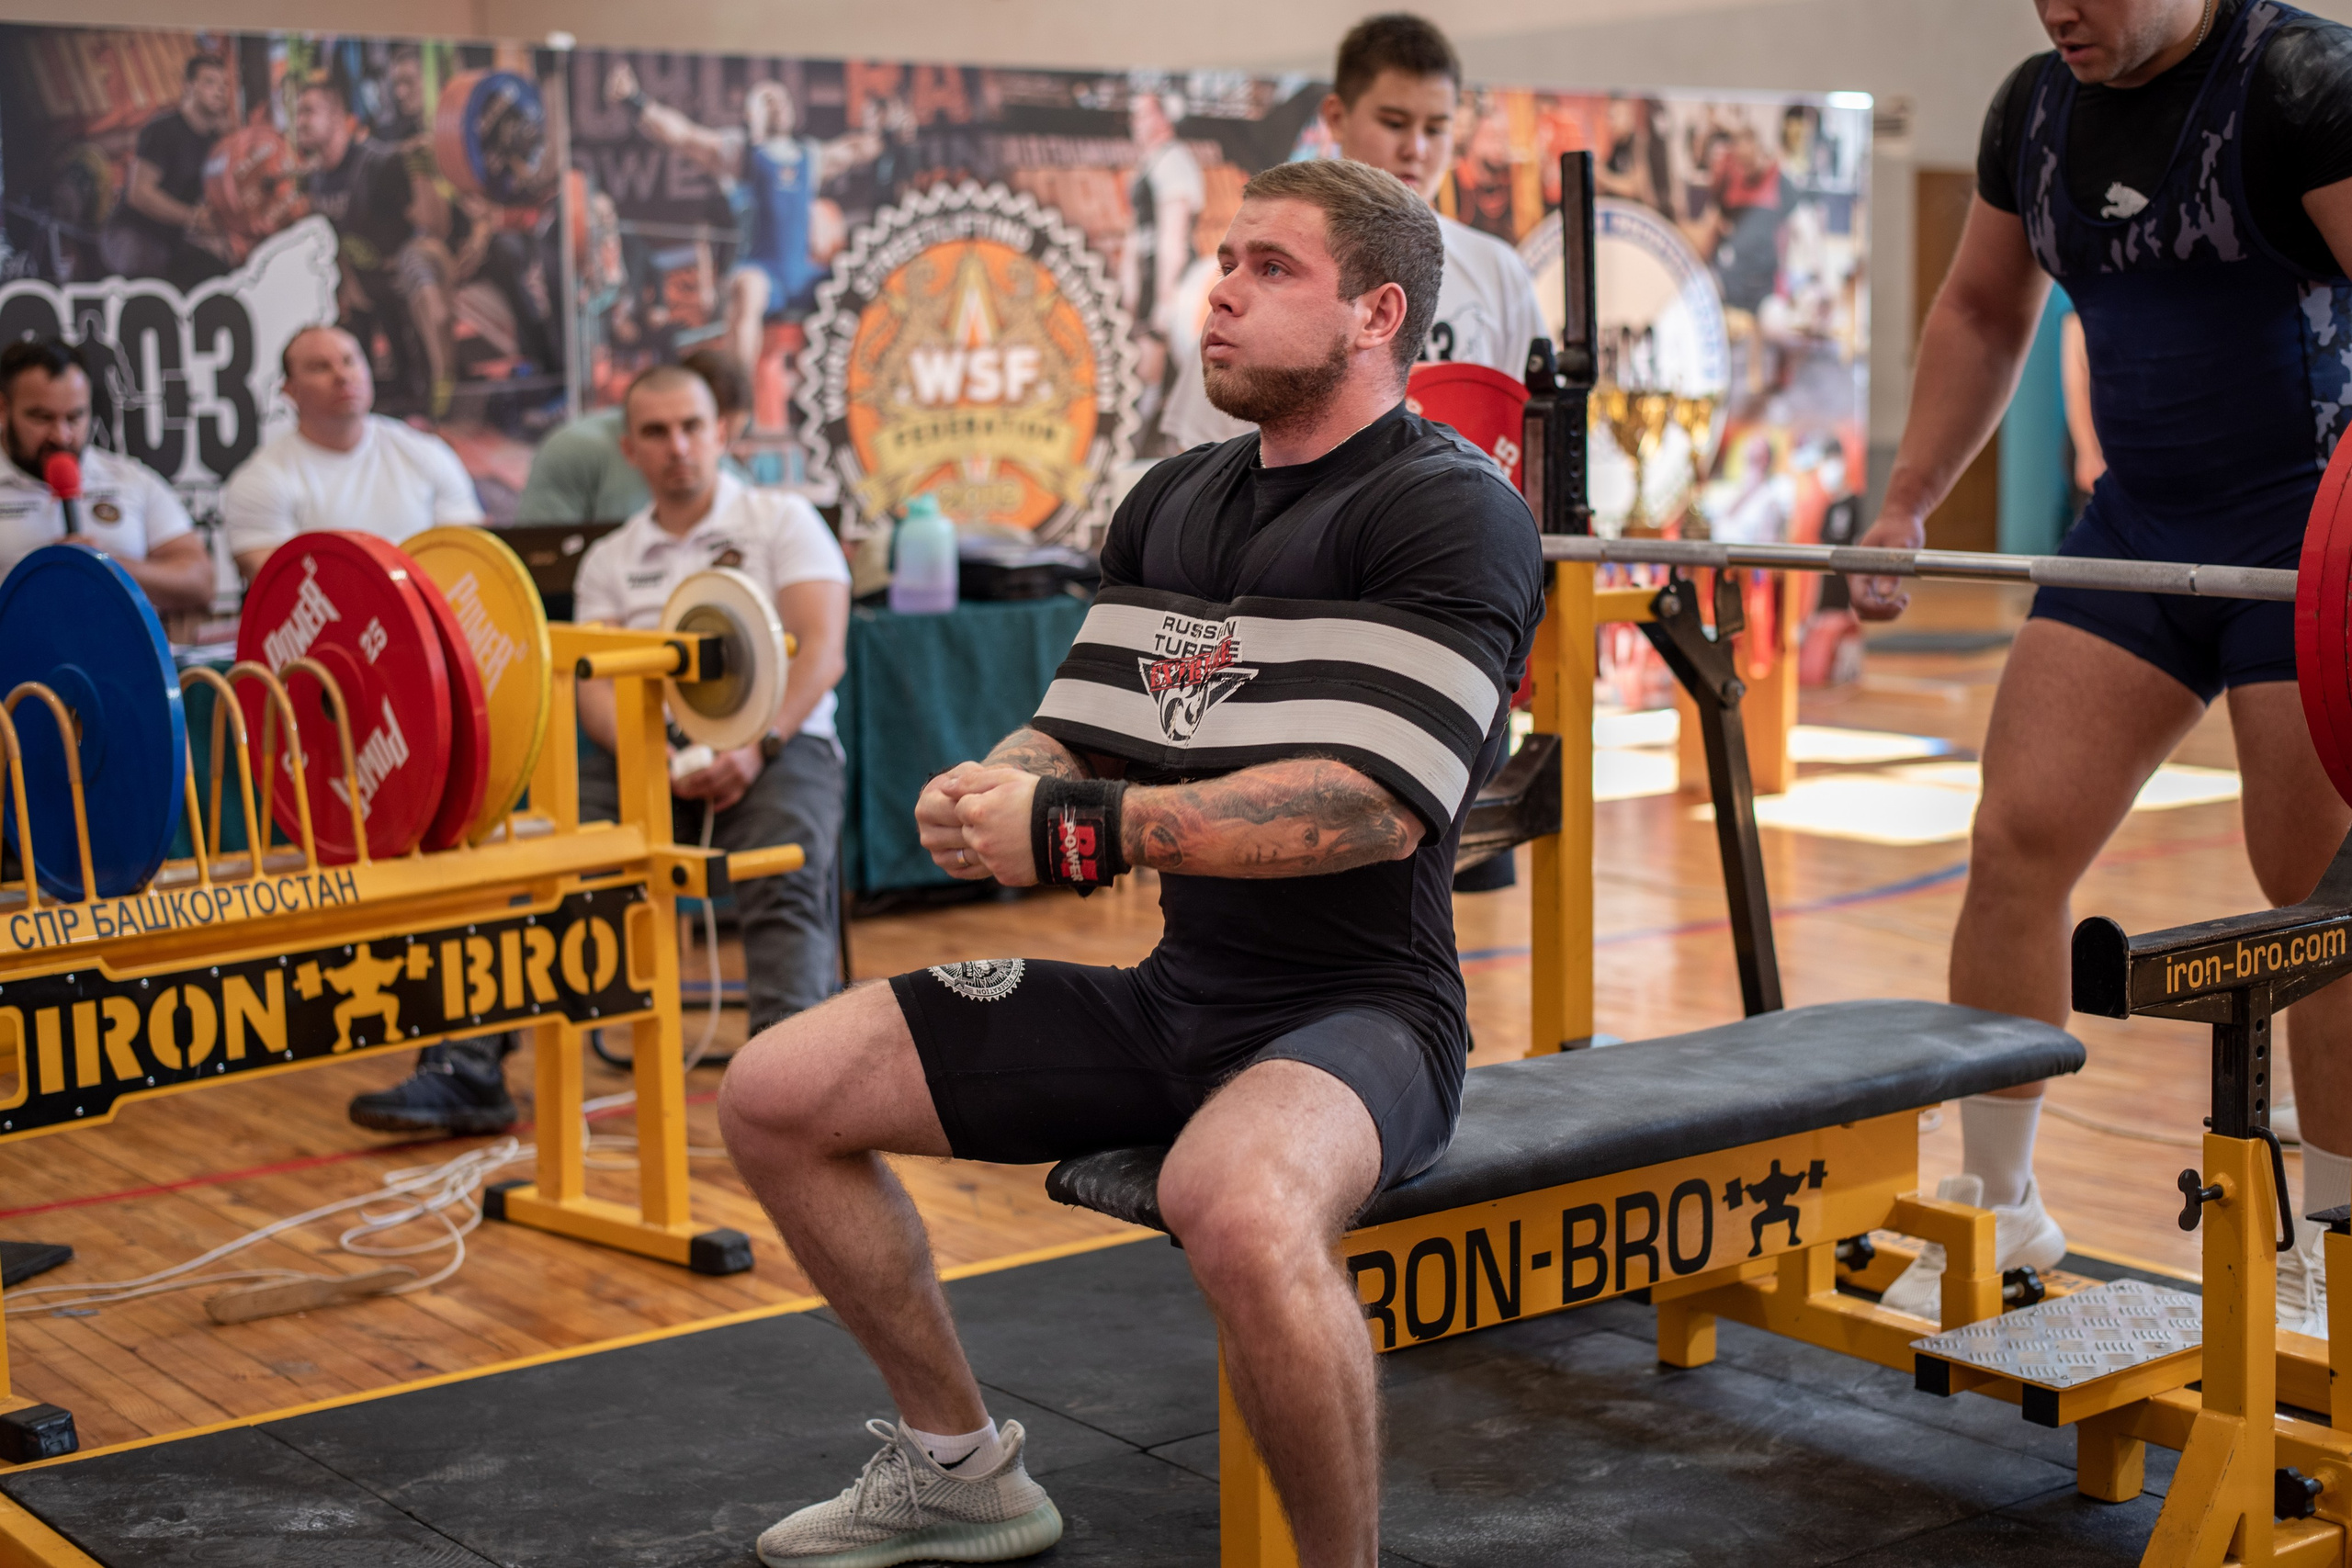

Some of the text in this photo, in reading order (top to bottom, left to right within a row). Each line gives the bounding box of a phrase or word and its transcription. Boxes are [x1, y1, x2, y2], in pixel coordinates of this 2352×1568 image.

[908, 345, 1042, 404] WSF
[1162, 615, 1238, 641] RUSSAN
[1063, 816, 1085, 882] POWER
[10, 869, 360, 950] СПР БАШКОРТОСТАН
[976, 976, 1013, 996] FEDERATION
[2166, 928, 2346, 995] iron-bro.com
[35, 918, 619, 1095] IRON BRO
[1345, 1178, 1714, 1349] RON-BRO
